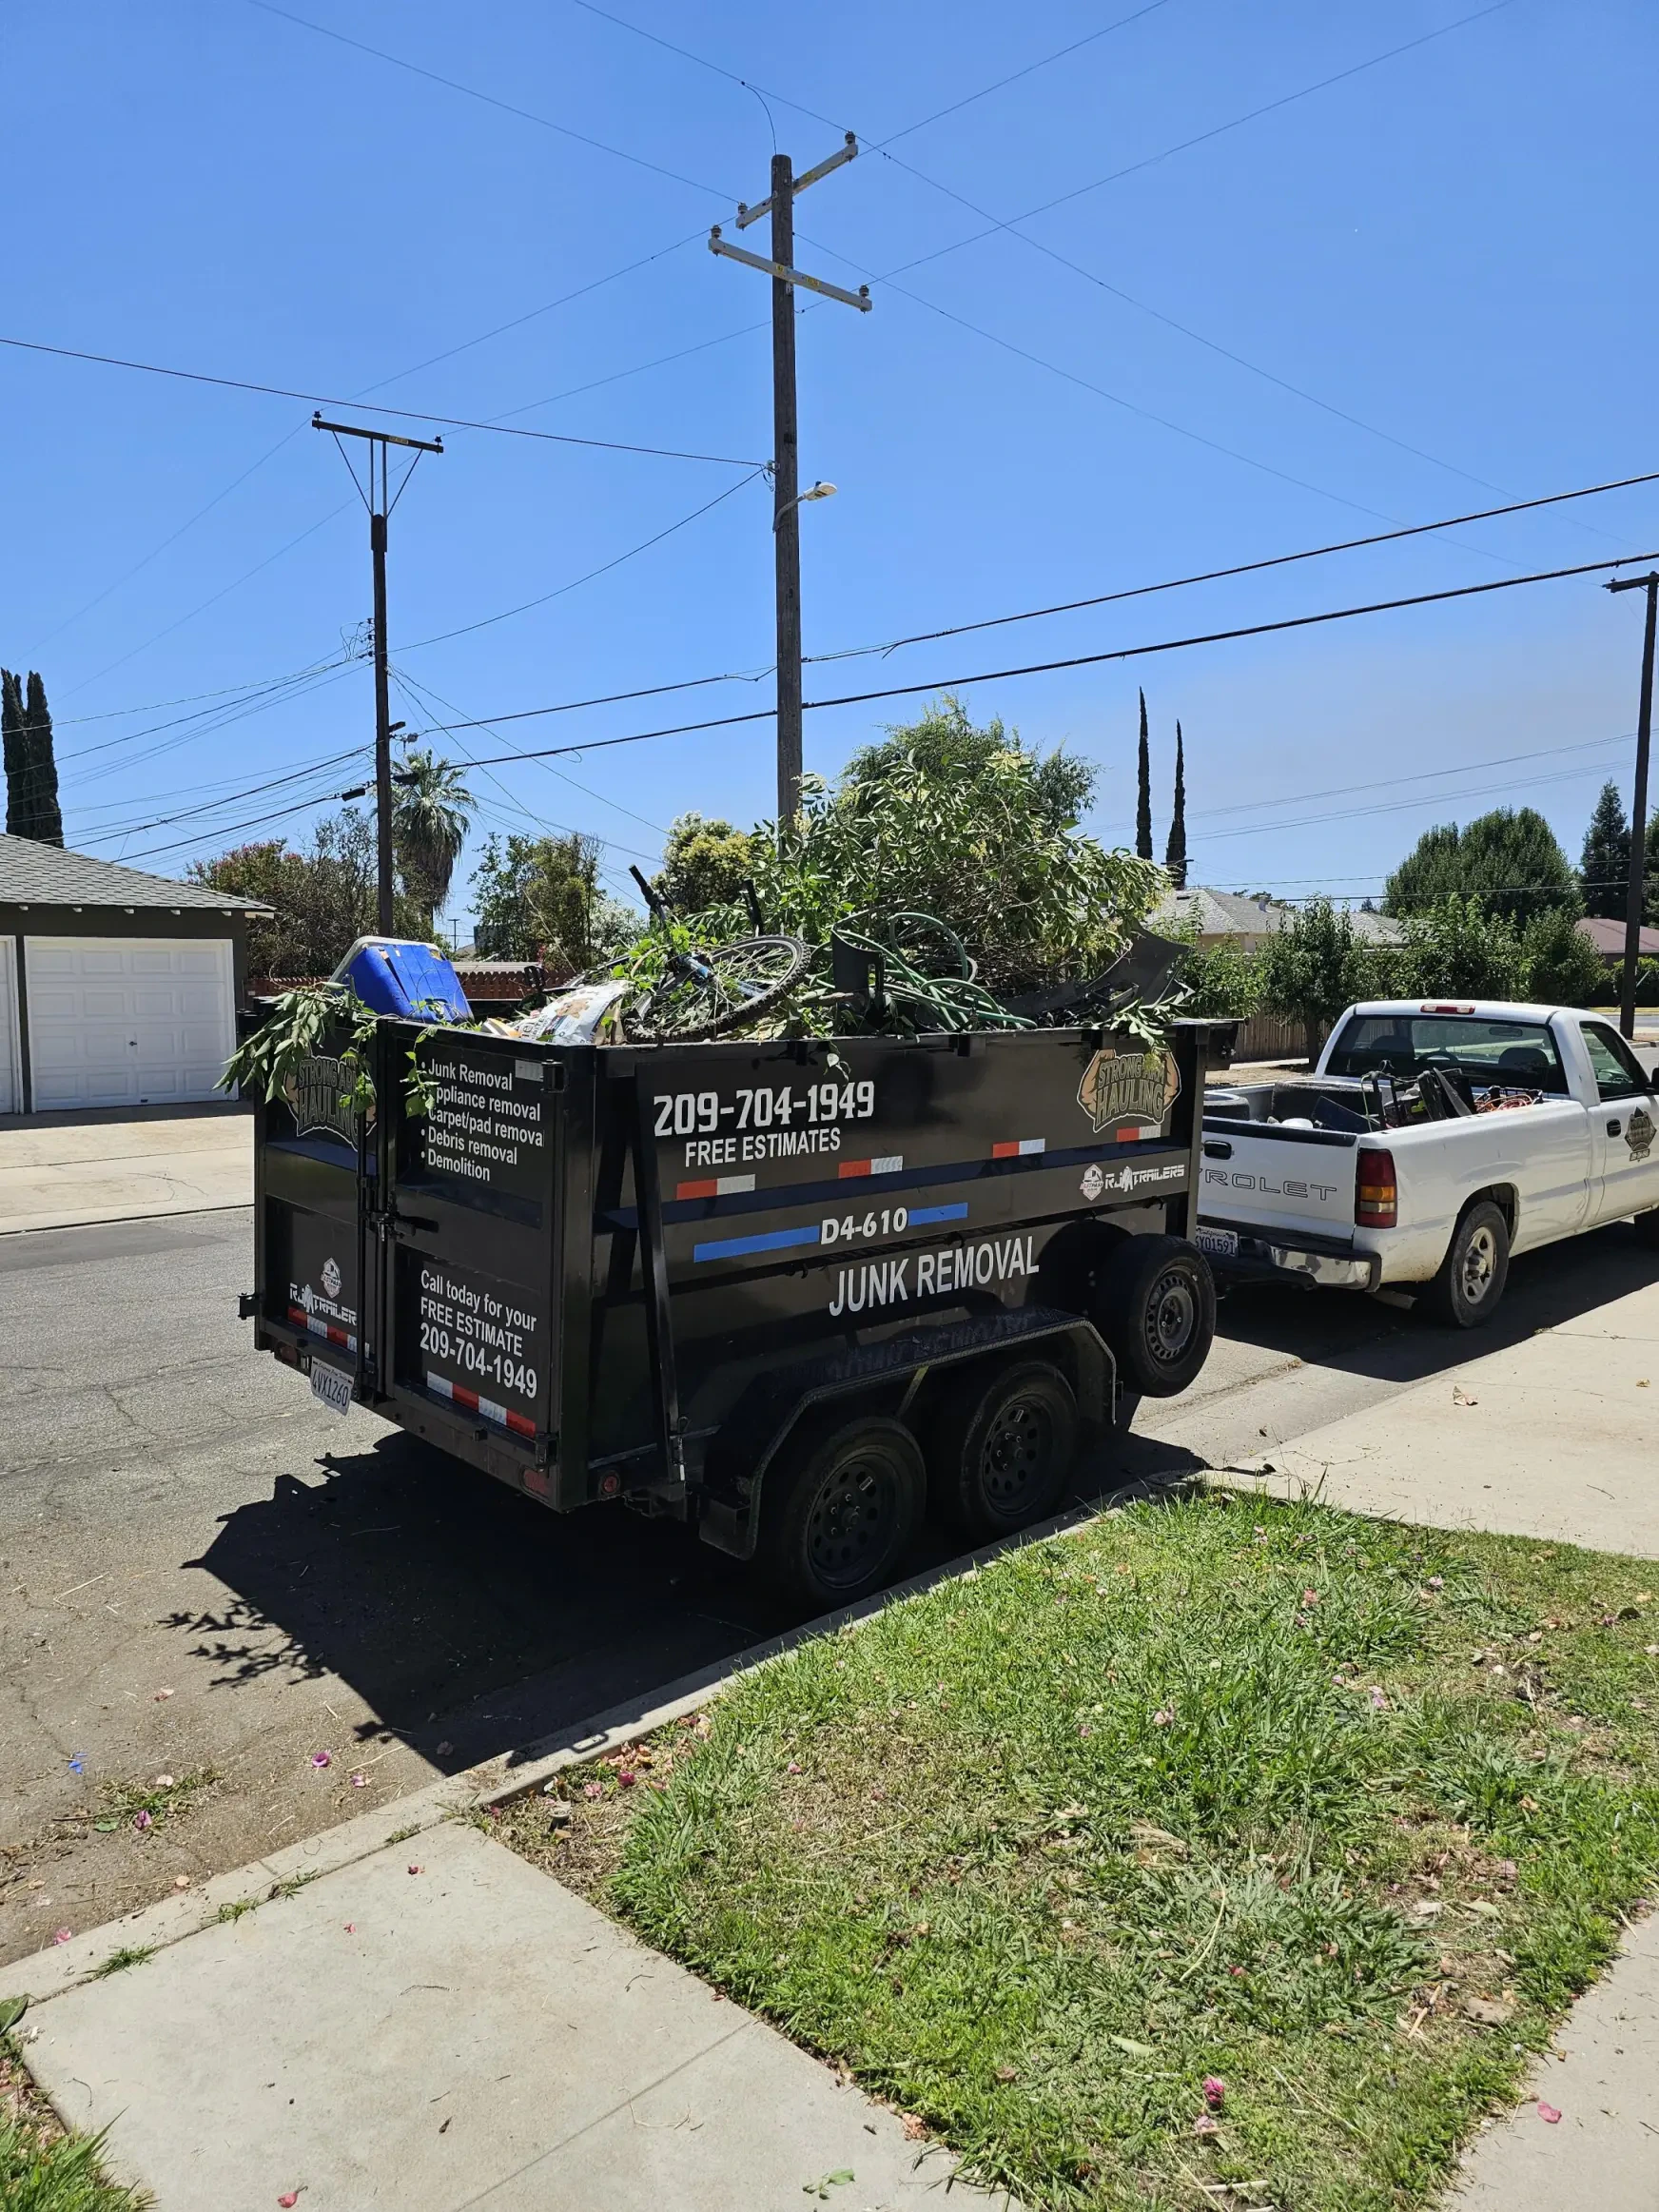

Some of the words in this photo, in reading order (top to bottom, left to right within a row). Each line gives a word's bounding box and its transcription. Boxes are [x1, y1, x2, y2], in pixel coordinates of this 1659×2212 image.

[298, 1057, 339, 1088] STRONG
[428, 1058, 457, 1081] Junk
[459, 1064, 513, 1091] Removal
[1099, 1055, 1142, 1087] STRONG
[434, 1086, 486, 1109] ppliance
[489, 1097, 540, 1122] removal
[654, 1080, 875, 1137] 209-704-1949
[1096, 1078, 1163, 1127] HAULING
[428, 1106, 492, 1135] Carpet/pad
[495, 1122, 544, 1147] remova
[428, 1126, 465, 1151] Debris
[468, 1140, 517, 1165] removal
[685, 1138, 737, 1167] FREE
[742, 1126, 841, 1162] ESTIMATES
[428, 1148, 491, 1182] Demolition
[820, 1206, 908, 1244] D4-610
[829, 1258, 909, 1317] JUNK
[916, 1236, 1040, 1298] REMOVAL
[420, 1269, 443, 1296] Call
[446, 1280, 481, 1314] today
[483, 1293, 503, 1319] for
[505, 1306, 537, 1332] your
[420, 1296, 454, 1328] FREE
[457, 1310, 523, 1358] ESTIMATE
[420, 1321, 537, 1399] 209-704-1949
[312, 1369, 349, 1407] 4VX1260
